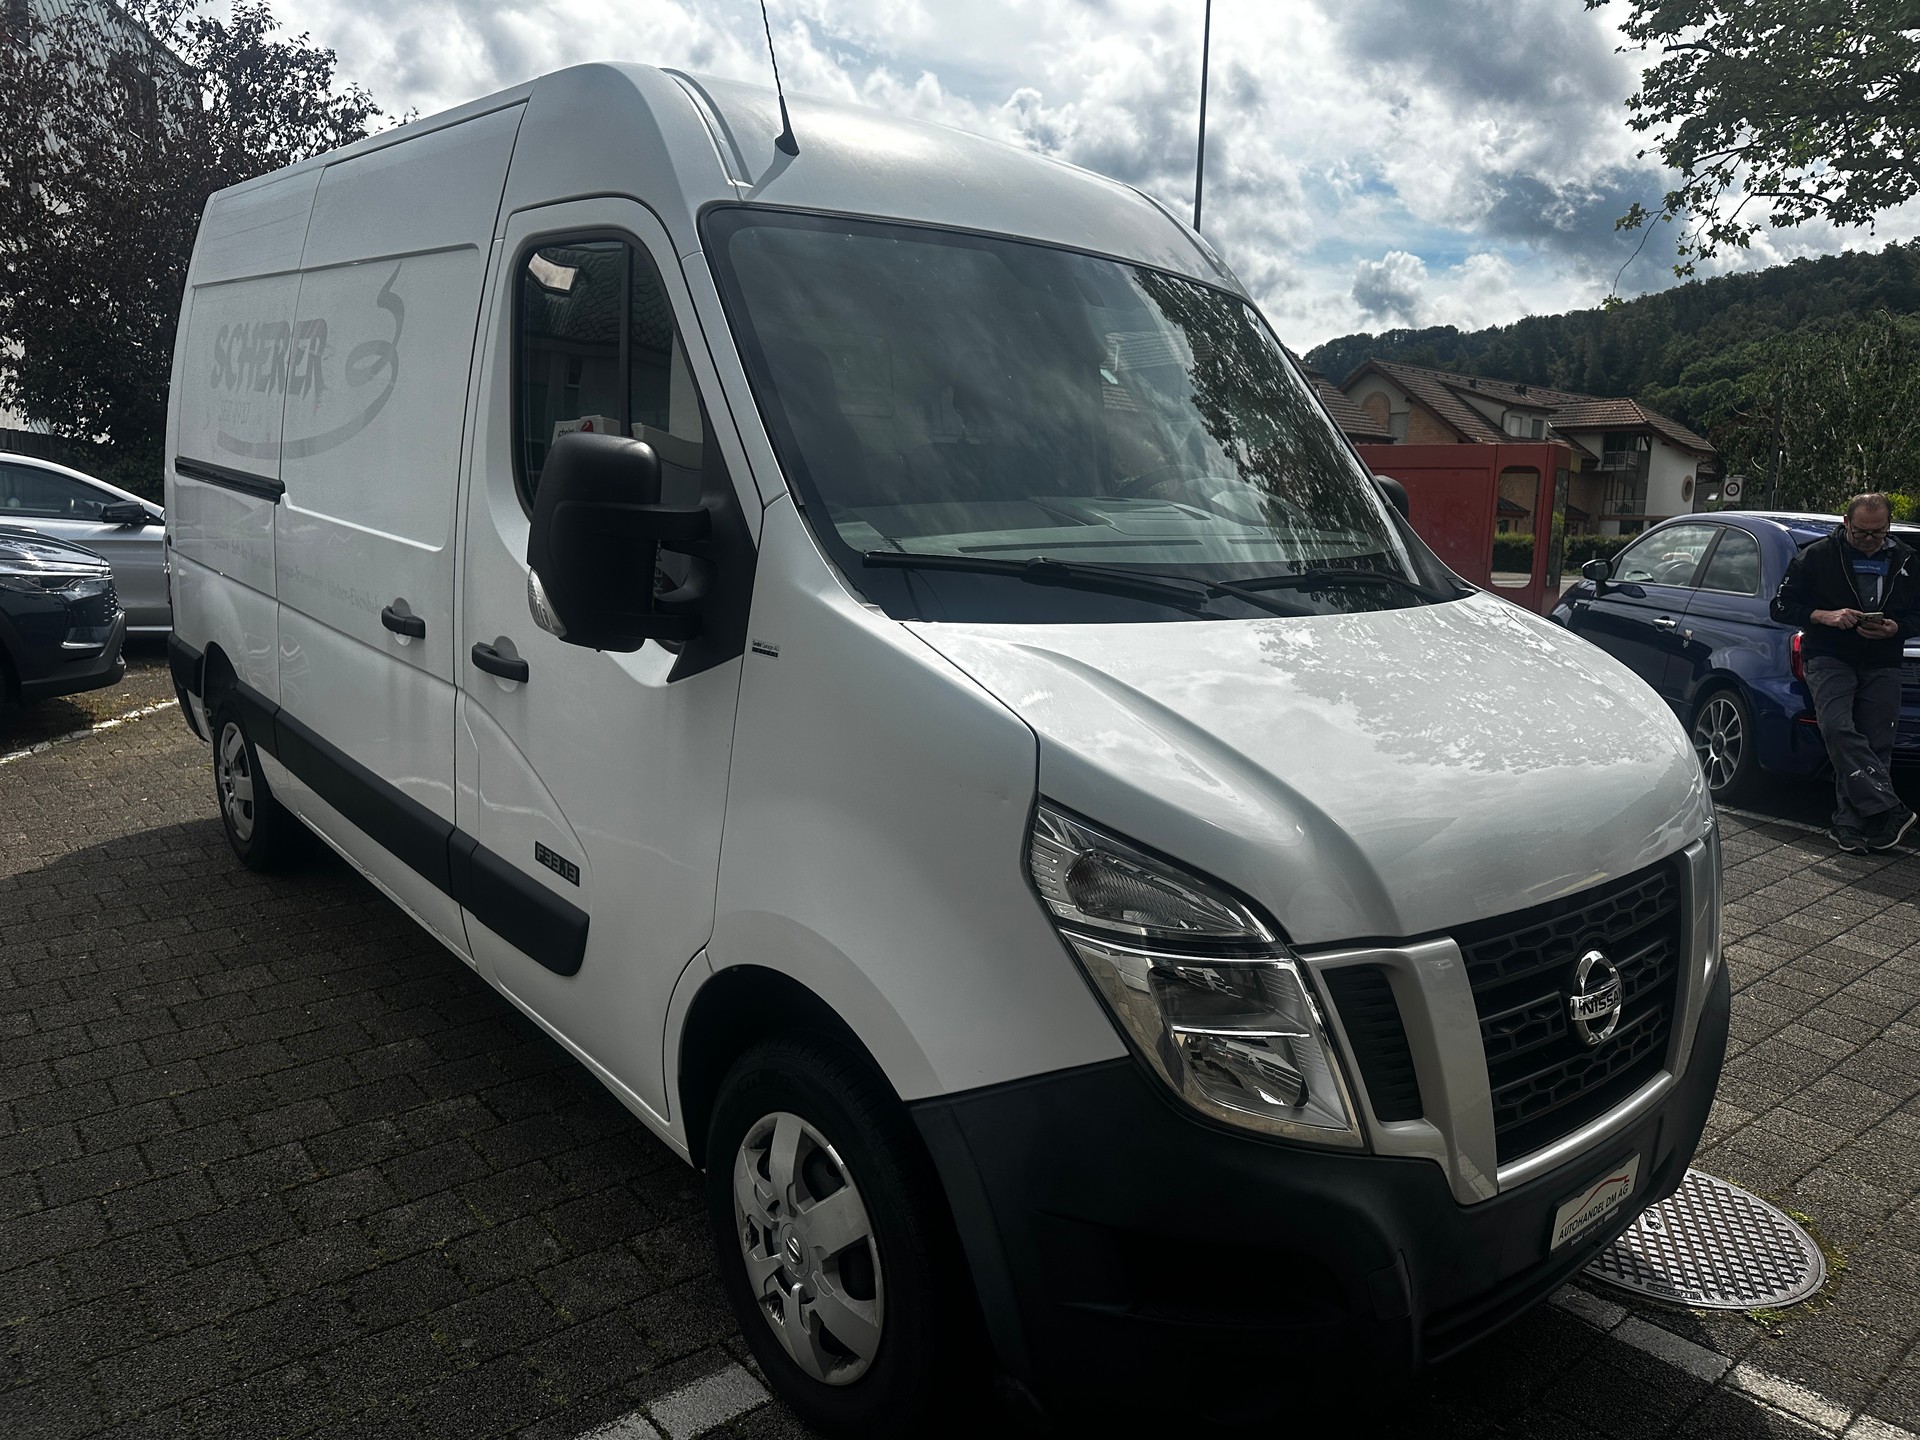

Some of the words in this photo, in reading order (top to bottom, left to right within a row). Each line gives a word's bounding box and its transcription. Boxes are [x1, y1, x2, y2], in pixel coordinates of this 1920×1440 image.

[210, 317, 328, 400] SCHERER
[537, 845, 577, 882] F33.13
[1558, 1202, 1605, 1241] AUTOHANDEL
[1606, 1192, 1618, 1208] DM
[1618, 1184, 1629, 1199] AG
